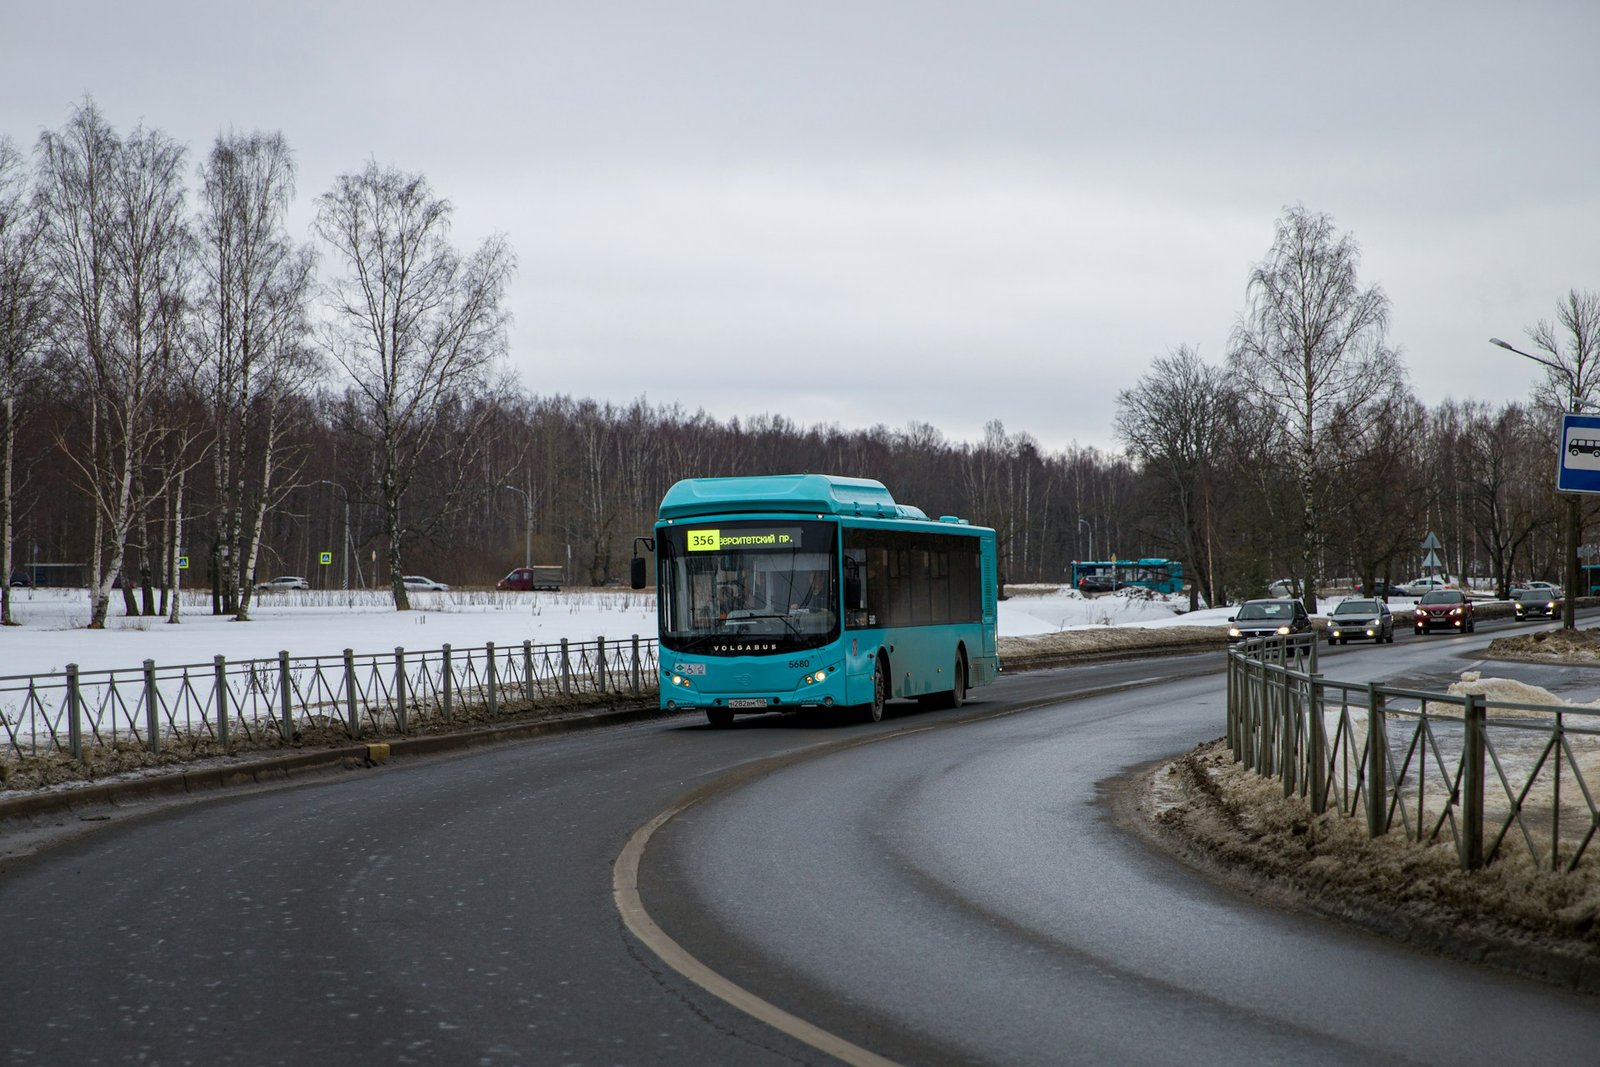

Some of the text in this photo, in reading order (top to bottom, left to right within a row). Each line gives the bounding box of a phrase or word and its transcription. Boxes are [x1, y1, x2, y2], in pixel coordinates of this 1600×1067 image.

[693, 535, 714, 546] 356
[713, 644, 777, 652] VOLGABUS
[788, 659, 810, 669] 5680
